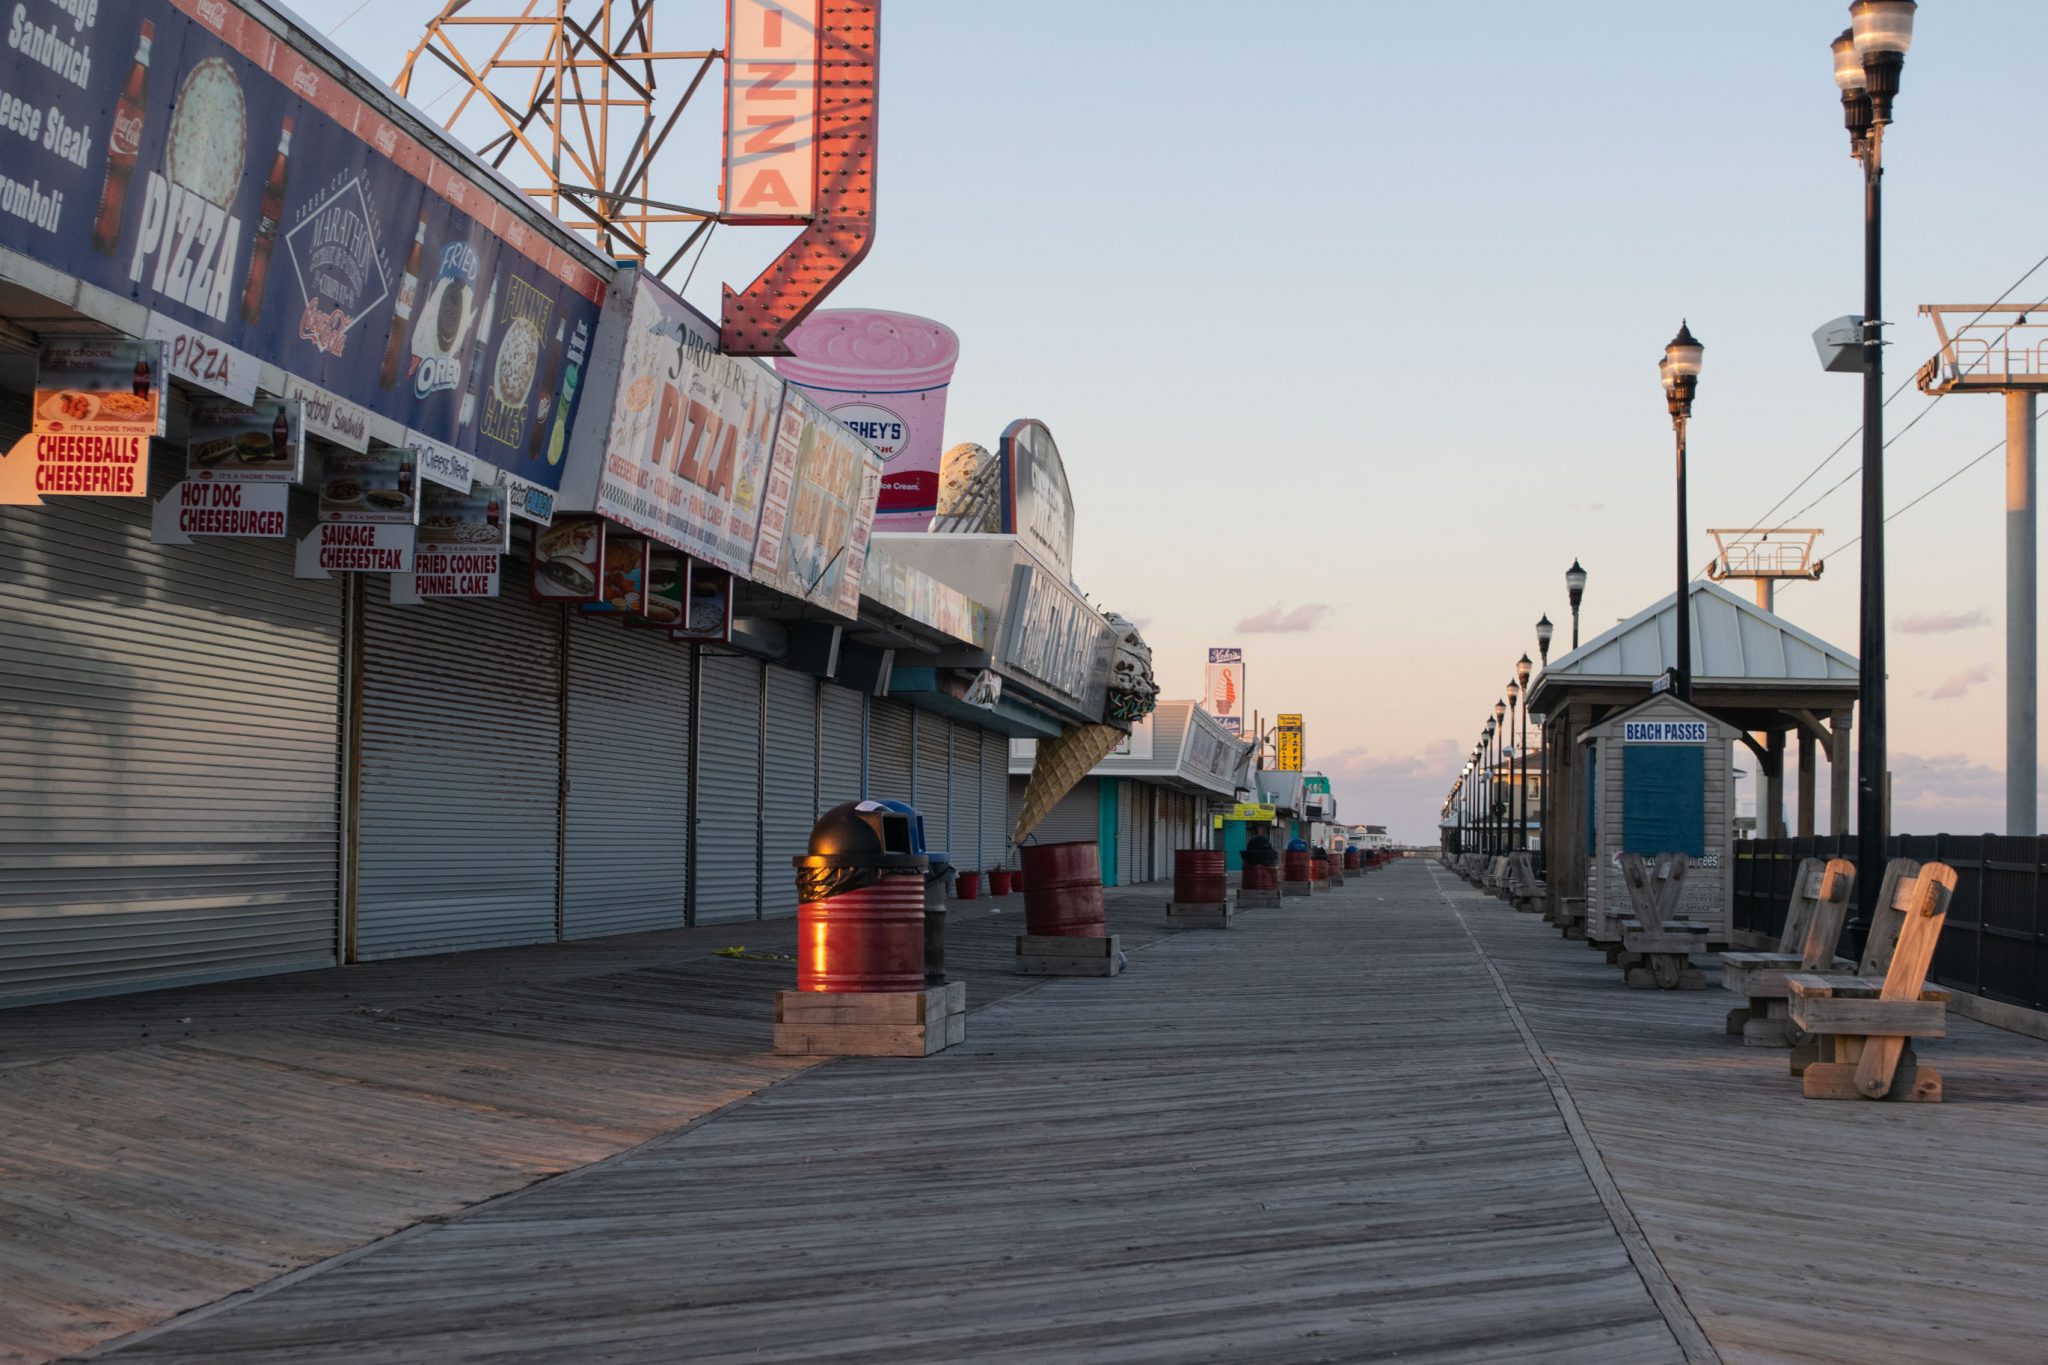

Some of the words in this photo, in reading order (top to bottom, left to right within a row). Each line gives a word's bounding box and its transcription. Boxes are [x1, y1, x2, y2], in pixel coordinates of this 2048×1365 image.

[8, 3, 92, 90] Sandwich
[0, 90, 42, 141] eese
[43, 106, 92, 169] Steak
[129, 170, 241, 323] PIZZA
[439, 242, 478, 281] FRIED
[501, 273, 555, 349] FUNNEL
[172, 334, 230, 387] PIZZA
[668, 322, 687, 380] 3
[416, 356, 462, 396] OREO
[294, 388, 332, 424] Matball
[480, 386, 529, 449] CAKES
[651, 382, 738, 502] PIZZA
[842, 421, 901, 440] SHEY'S
[37, 435, 139, 464] CHEESEBALLS
[425, 446, 450, 476] Cheese
[450, 455, 470, 481] Steak
[35, 464, 134, 493] CHEESEFRIES
[608, 453, 649, 490] CHEESESTEAKS
[181, 483, 209, 507] HOT
[212, 483, 241, 507] DOG
[179, 508, 285, 535] CHEESEBURGER
[321, 525, 375, 547] SAUSAGE
[319, 547, 402, 570] CHEESESTEAK
[416, 554, 447, 574] FRIED
[450, 554, 497, 574] COOKIES
[415, 575, 458, 594] FUNNEL
[460, 575, 488, 594] CAKE
[1626, 723, 1662, 740] BEACH
[1664, 723, 1705, 740] PASSES
